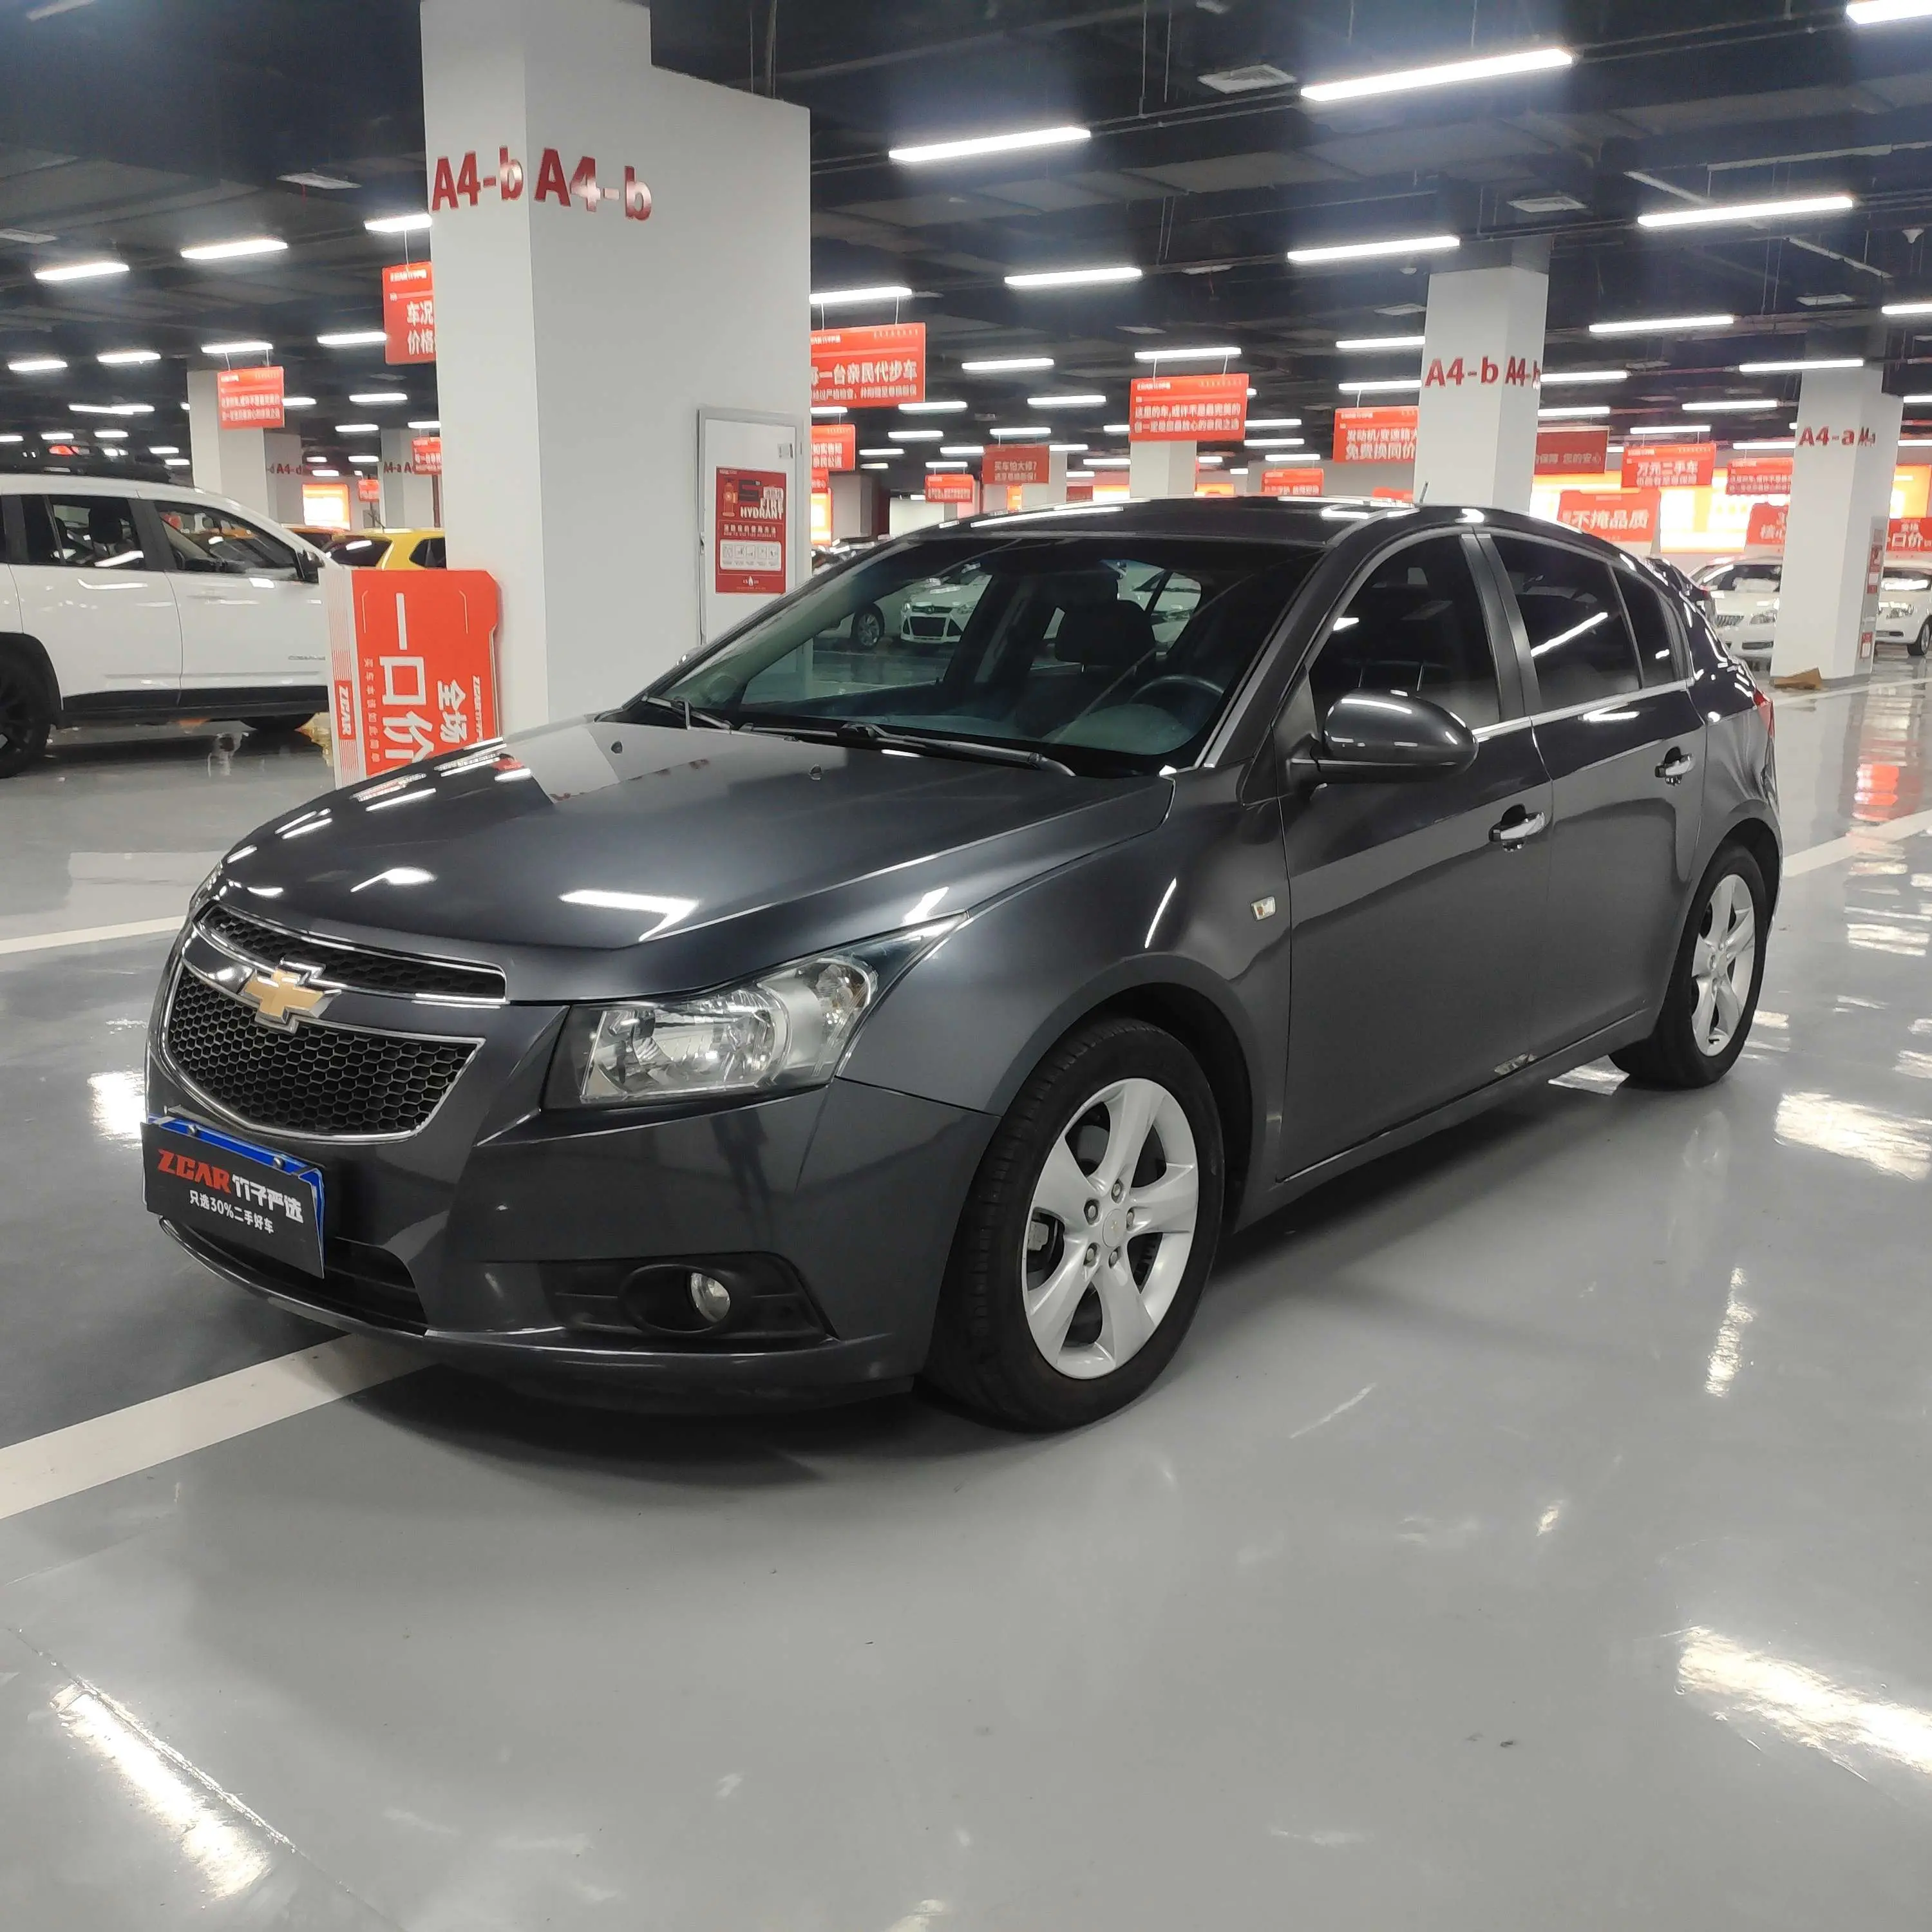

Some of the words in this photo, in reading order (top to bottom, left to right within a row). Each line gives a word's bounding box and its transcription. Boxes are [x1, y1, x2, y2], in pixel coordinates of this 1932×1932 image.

[431, 146, 524, 213] A4-b
[535, 147, 652, 222] A4-b
[1425, 355, 1499, 388] A4-b
[1798, 426, 1855, 447] A4-a
[740, 506, 783, 520] HYDRANT
[379, 592, 435, 762] 一口价
[437, 679, 469, 744] 全场
[157, 1148, 233, 1193] ZCAR
[232, 1173, 304, 1223] 竹子严选
[189, 1189, 274, 1235] 只选30%二手好车
